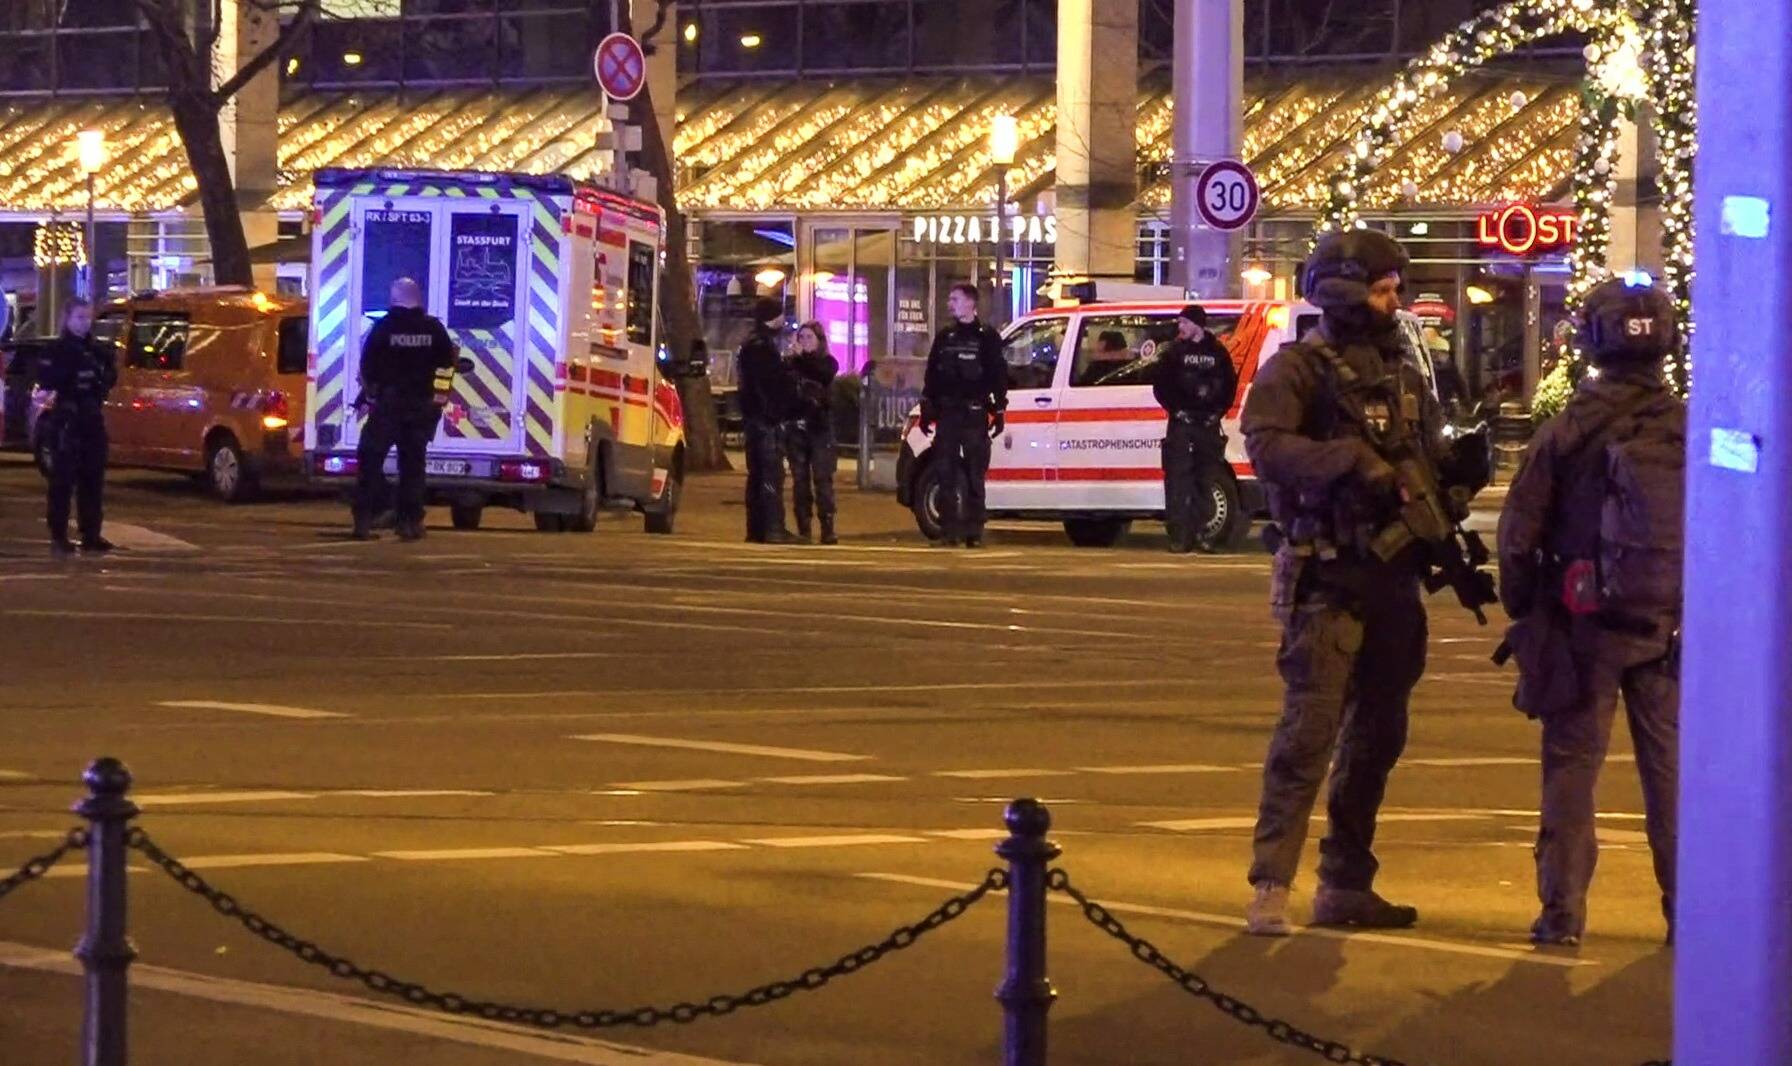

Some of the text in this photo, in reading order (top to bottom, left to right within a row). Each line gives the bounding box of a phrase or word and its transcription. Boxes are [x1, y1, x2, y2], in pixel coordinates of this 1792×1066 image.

[1211, 181, 1245, 211] 30
[914, 216, 981, 243] PIZZA
[456, 235, 511, 245] STASSFURT
[1628, 318, 1653, 335] ST
[390, 334, 432, 347] POLIZEI
[1184, 354, 1215, 367] POLIZEI
